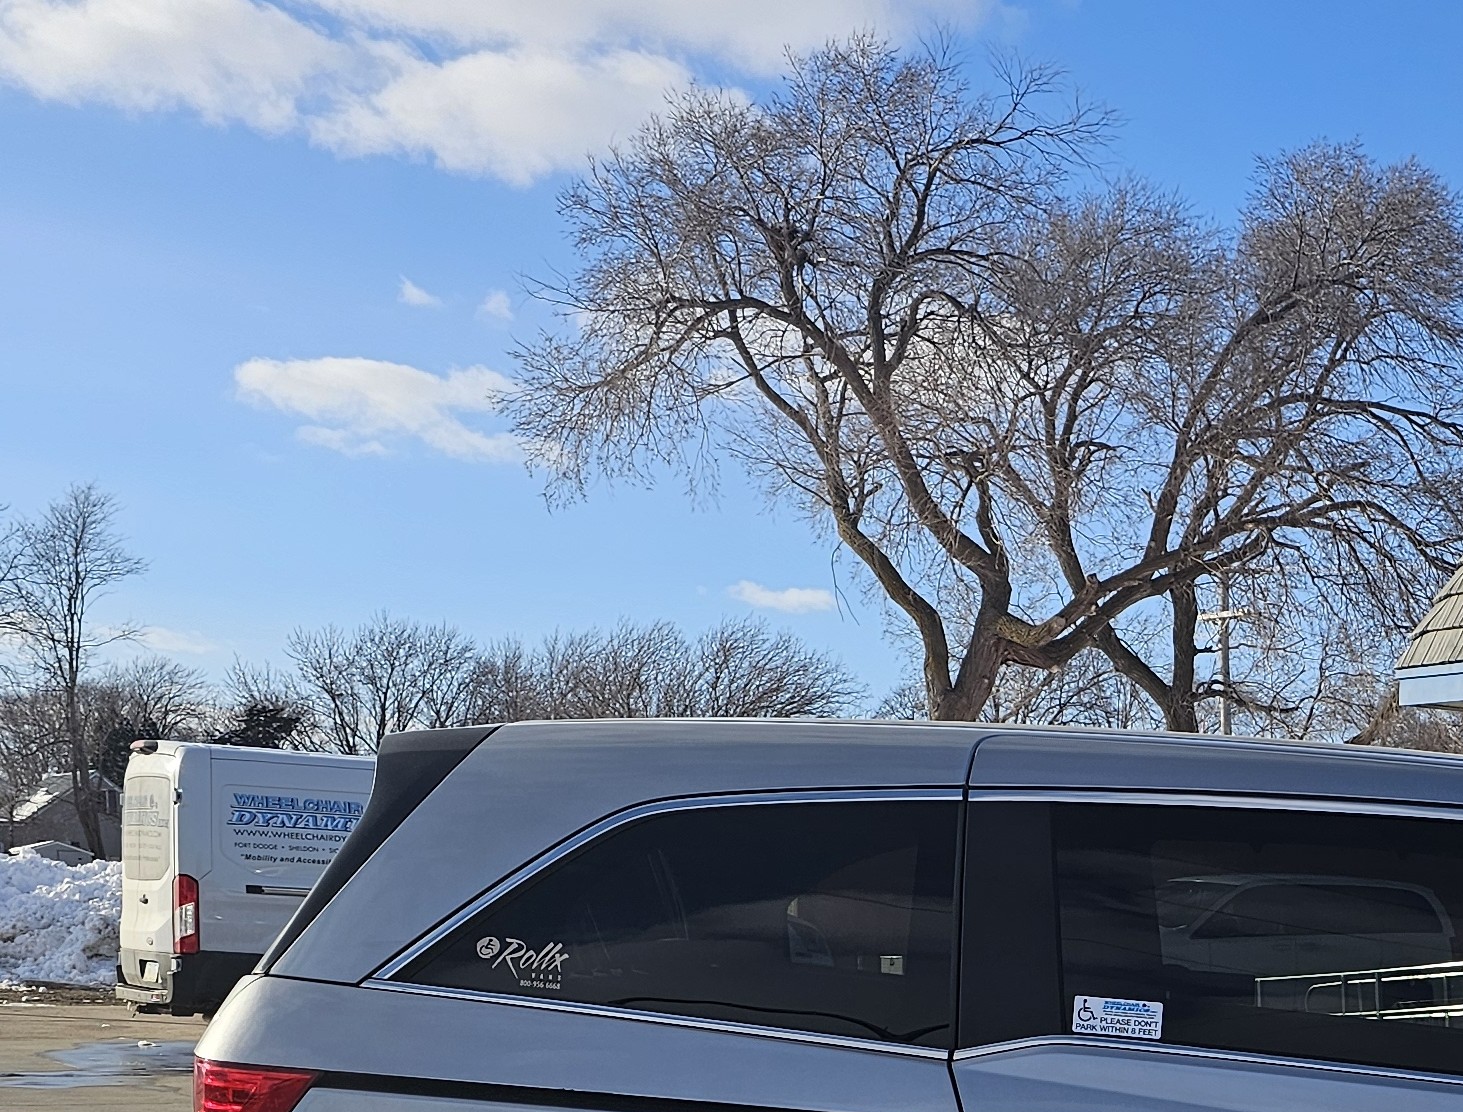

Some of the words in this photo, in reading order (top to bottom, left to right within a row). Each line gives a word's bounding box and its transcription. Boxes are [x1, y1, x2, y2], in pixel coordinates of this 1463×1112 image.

[233, 793, 364, 814] WHEELCHAIR
[1100, 1017, 1131, 1026] PLEASE
[1134, 1020, 1159, 1028] DON'T
[1075, 1023, 1097, 1031] PARK
[1100, 1025, 1129, 1034] WITHIN
[1138, 1028, 1158, 1036] FEET
